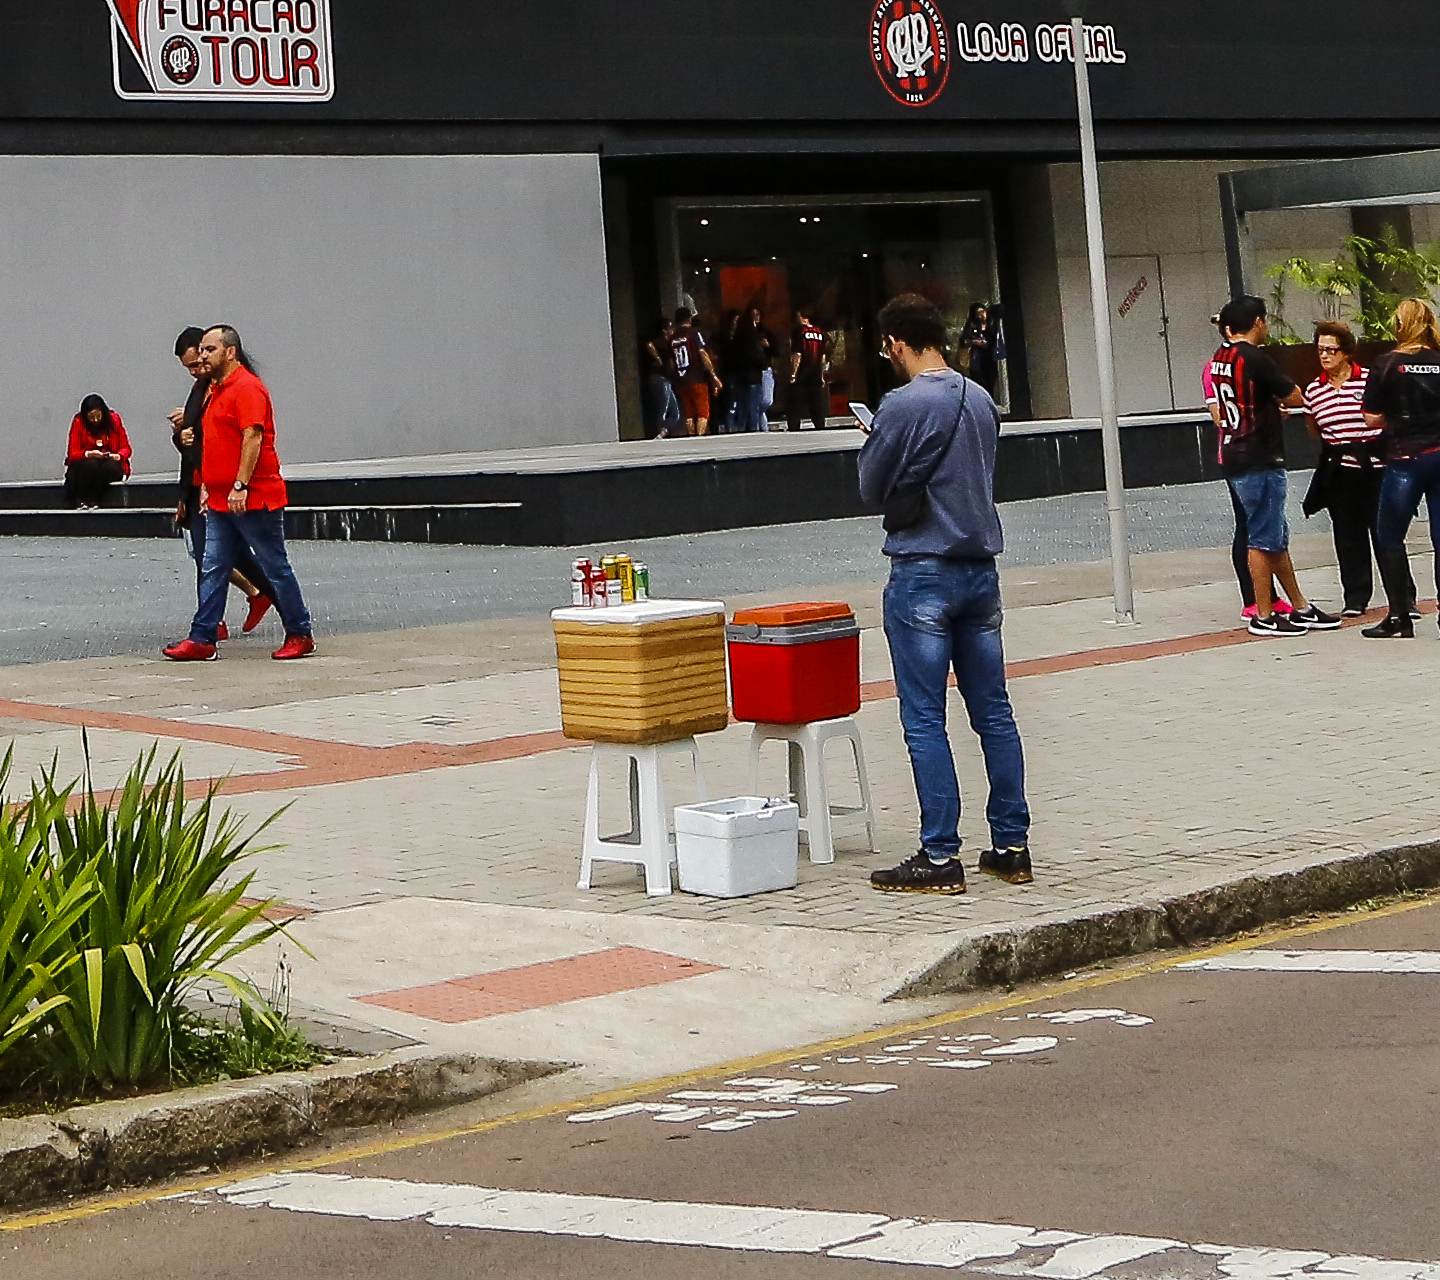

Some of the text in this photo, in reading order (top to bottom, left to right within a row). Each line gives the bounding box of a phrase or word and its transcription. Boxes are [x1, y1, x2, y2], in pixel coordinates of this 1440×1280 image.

[200, 35, 321, 88] TOUR
[957, 22, 1127, 64] LOJA OFIIAL
